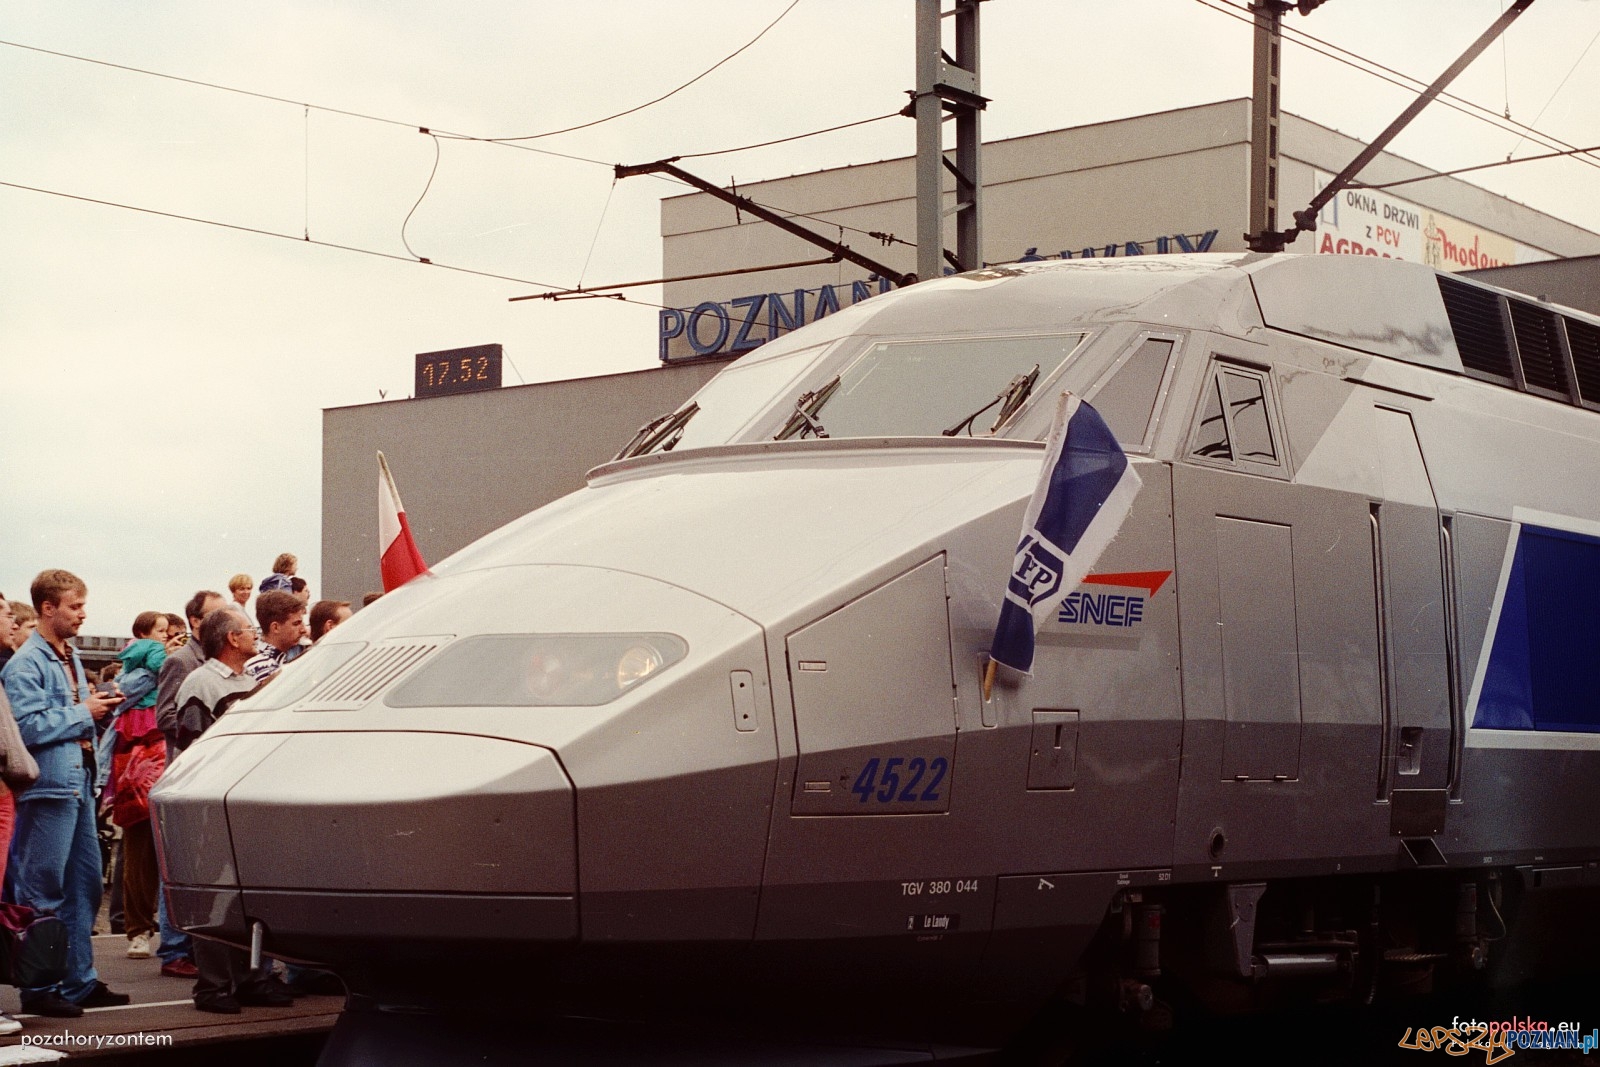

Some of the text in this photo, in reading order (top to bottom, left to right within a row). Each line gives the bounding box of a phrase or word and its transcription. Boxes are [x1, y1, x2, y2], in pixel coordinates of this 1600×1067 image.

[1346, 190, 1419, 230] OKNA DRZWI
[1376, 224, 1401, 248] PCV
[422, 356, 489, 386] 17.52
[1057, 591, 1145, 627] SNCF
[851, 756, 948, 803] 4522
[901, 879, 979, 896] TGV 380 044
[923, 914, 932, 928] Le
[932, 914, 950, 930] Landy
